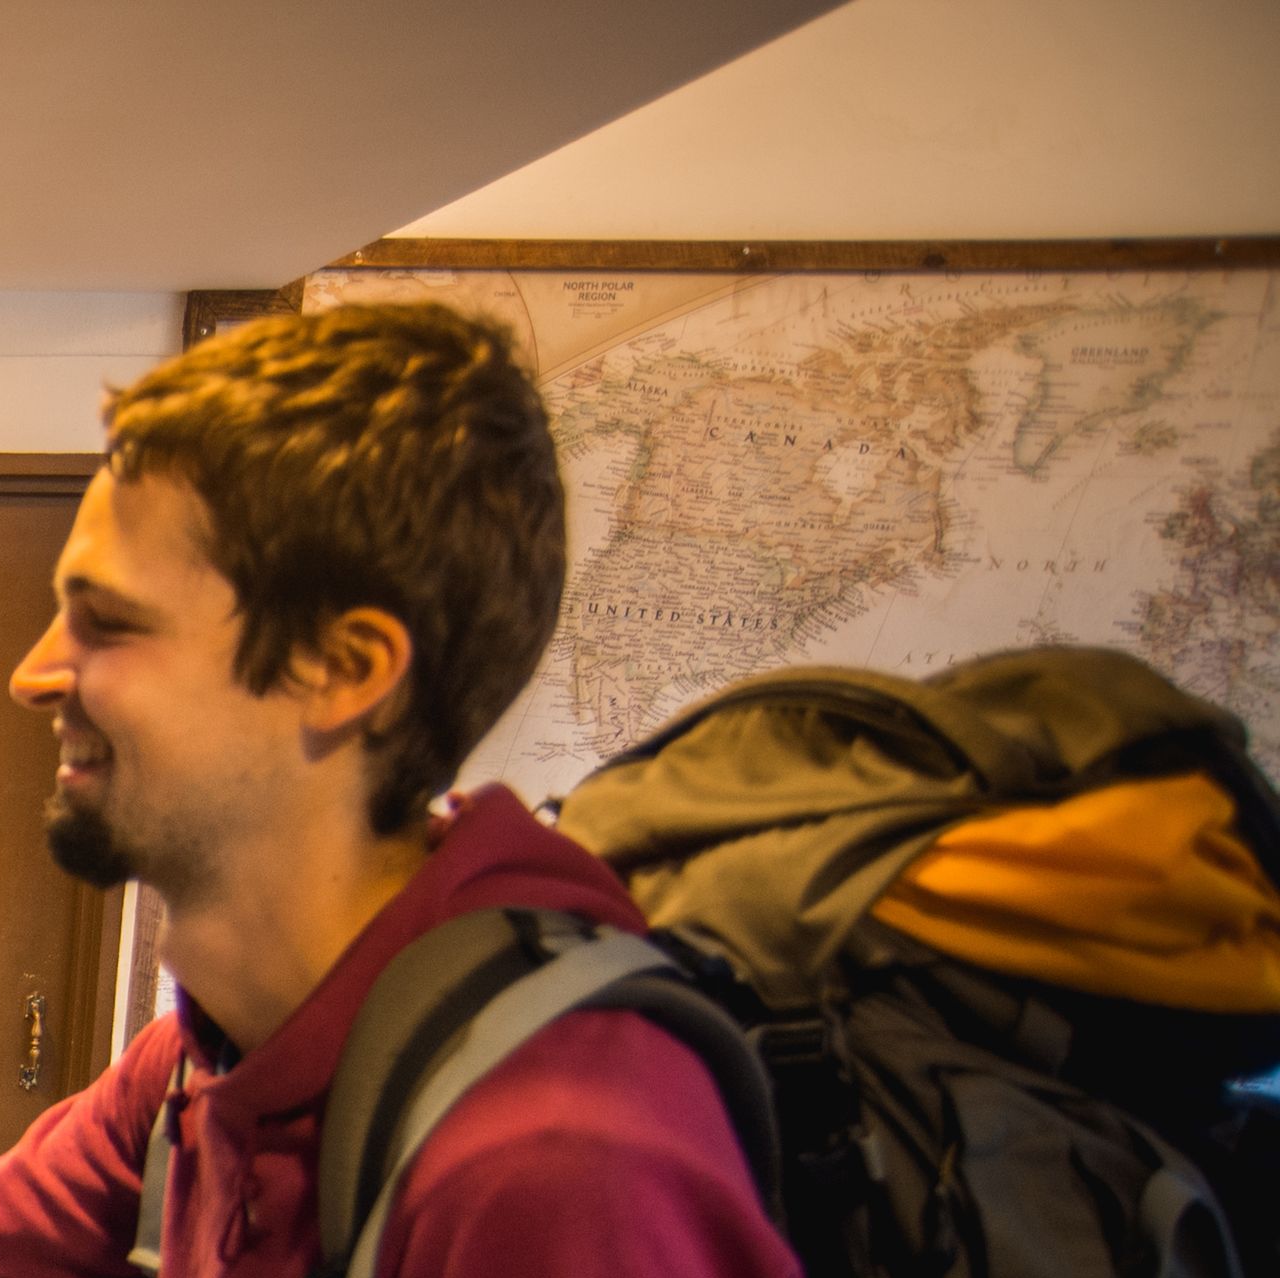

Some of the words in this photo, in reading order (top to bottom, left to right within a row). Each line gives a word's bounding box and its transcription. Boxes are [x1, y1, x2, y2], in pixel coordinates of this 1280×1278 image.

[563, 281, 599, 291] NORTH
[601, 281, 634, 291] POLAR
[578, 292, 616, 301] REGION
[625, 381, 669, 397] ALASKA
[709, 426, 906, 460] CANADA
[588, 602, 681, 622] UNITED
[696, 611, 779, 630] STATES
